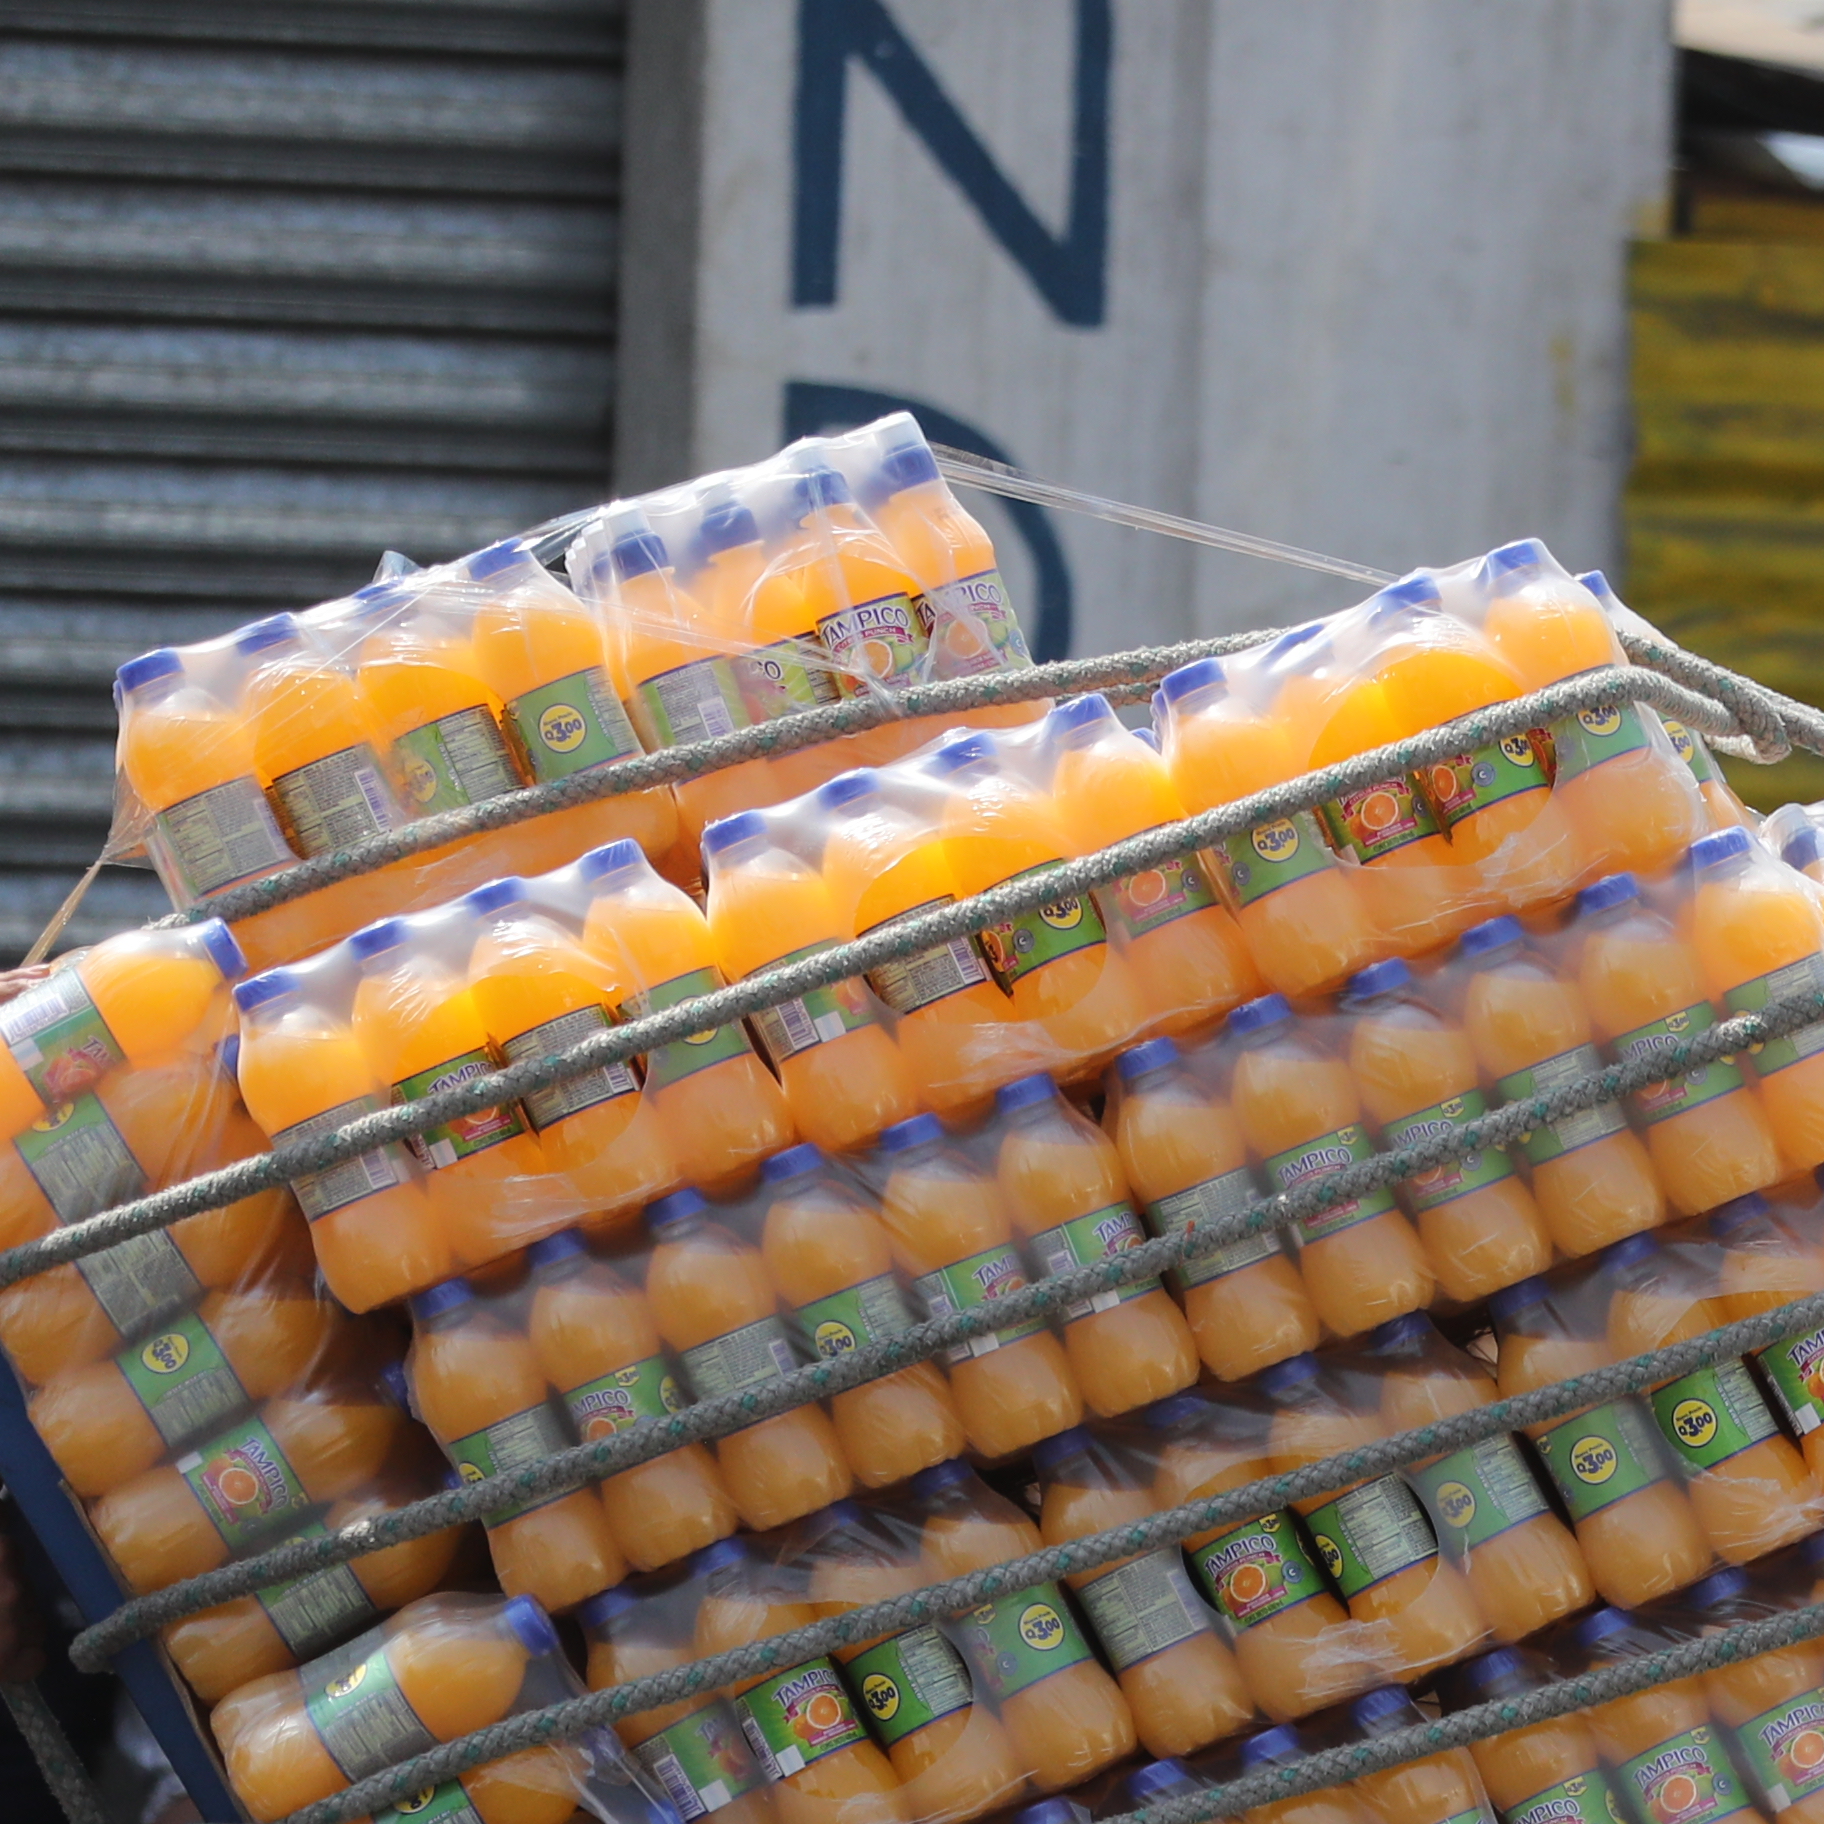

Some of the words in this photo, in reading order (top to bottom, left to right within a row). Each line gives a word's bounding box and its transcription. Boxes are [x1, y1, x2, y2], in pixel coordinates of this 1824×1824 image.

[916, 582, 1002, 624] TAPICO
[821, 606, 909, 646] TAMPICO
[1620, 1034, 1678, 1059] MPICO
[427, 1060, 494, 1094] TAMPIC
[1278, 1146, 1352, 1184] TAMPICO
[1094, 1212, 1131, 1243] TAMP
[573, 1388, 630, 1417] MPICO
[1678, 1412, 1713, 1437] Q3.00
[237, 1436, 290, 1511] TAMPICO
[1577, 1450, 1614, 1474] Q3.00
[1203, 1534, 1277, 1576] TAMPICO
[771, 1668, 842, 1708] TAMPIC
[1633, 1746, 1707, 1788] TAMPICO
